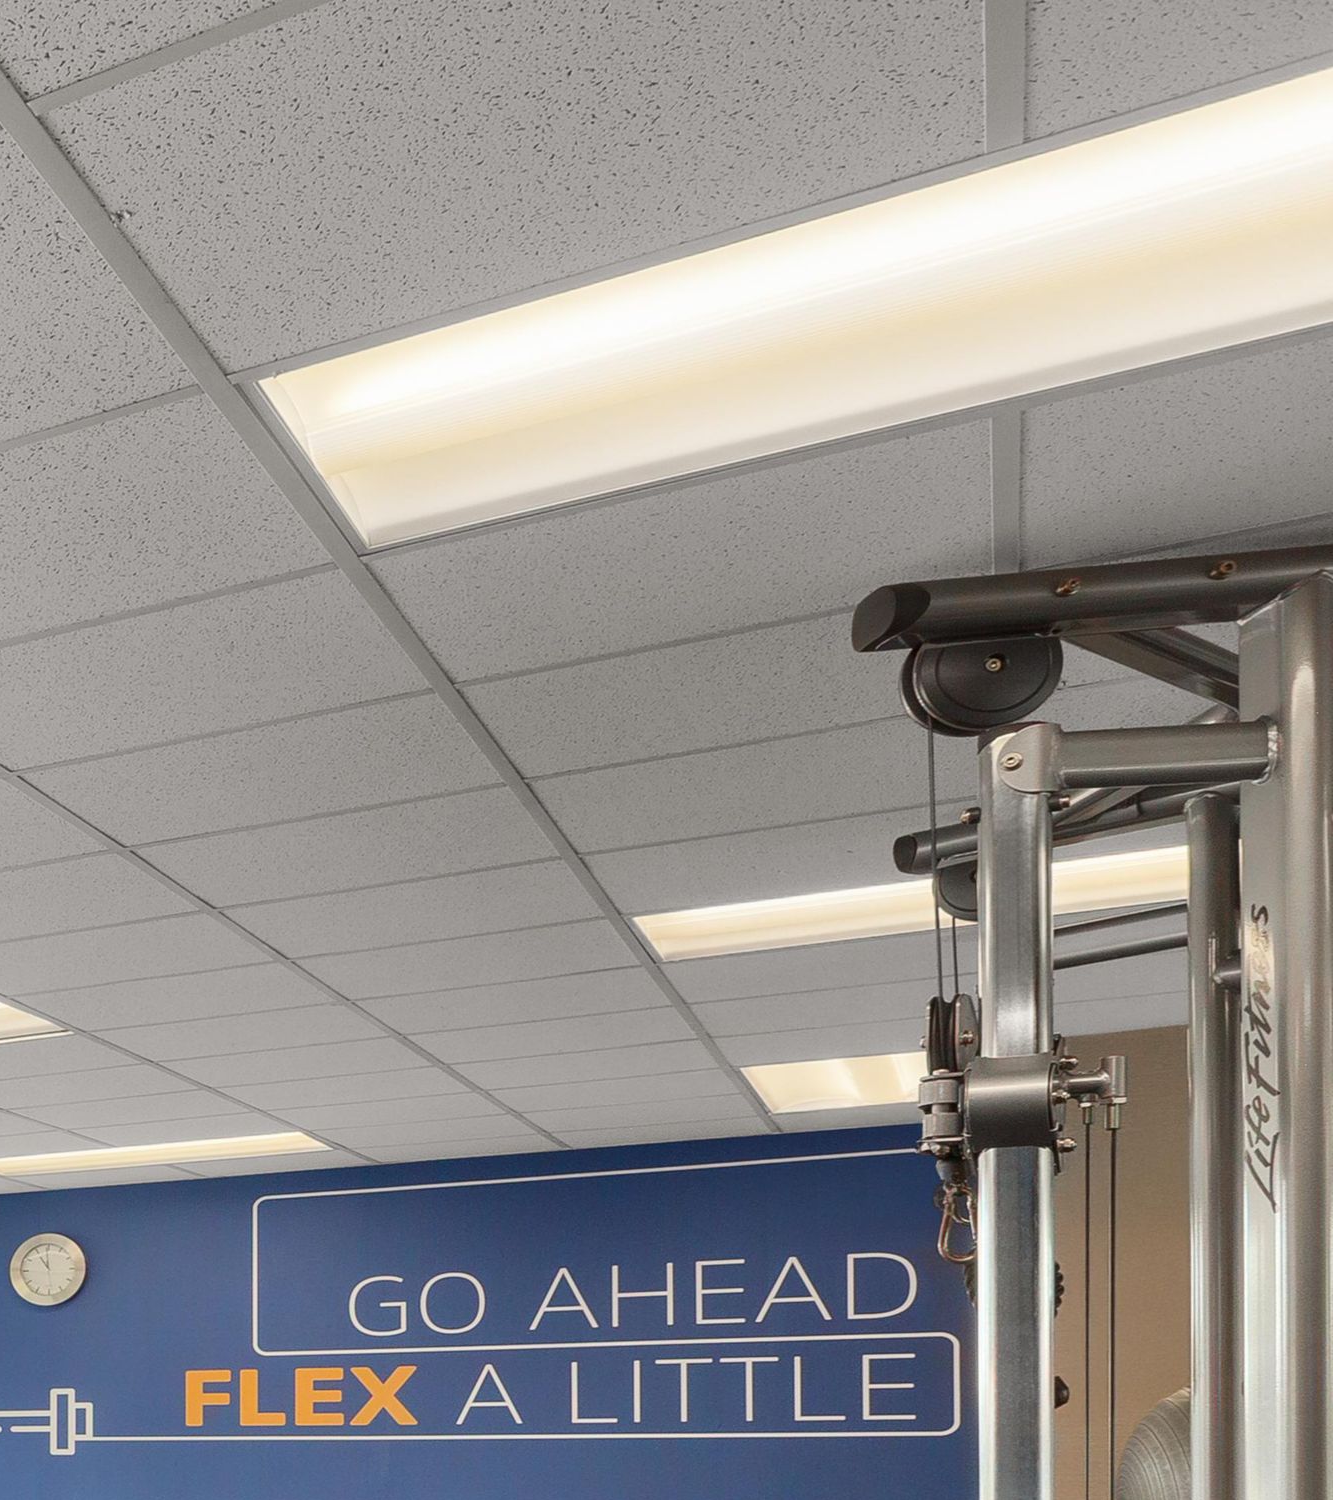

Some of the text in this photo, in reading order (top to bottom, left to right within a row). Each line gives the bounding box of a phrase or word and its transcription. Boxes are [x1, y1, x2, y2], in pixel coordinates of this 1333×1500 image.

[348, 1252, 918, 1337] GO AHEAD
[185, 1353, 917, 1427] FLEX A LITTLE
